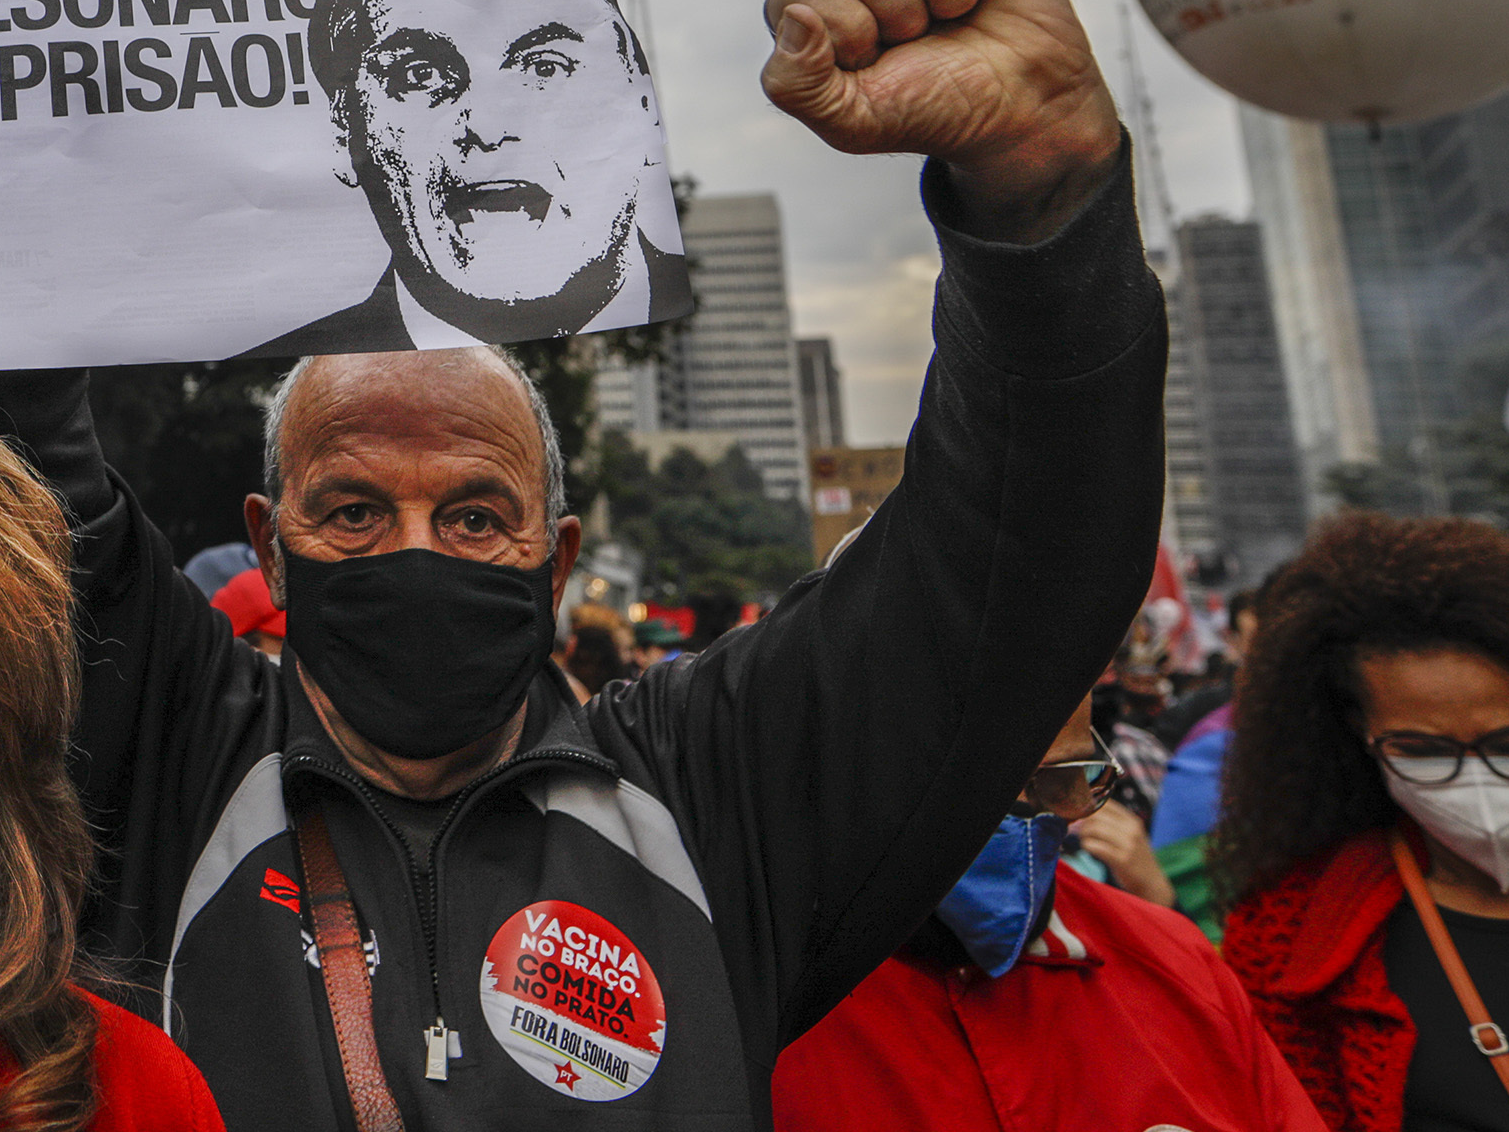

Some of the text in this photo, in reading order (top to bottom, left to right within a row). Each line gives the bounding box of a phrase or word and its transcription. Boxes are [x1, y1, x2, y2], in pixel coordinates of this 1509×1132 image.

[520, 932, 641, 998] NO BRAÇO.
[525, 909, 641, 979] VACINA
[513, 975, 628, 1038] NO PRATO.
[517, 954, 635, 1022] COMIDA
[510, 1005, 630, 1083] FORA BOLSONARO
[560, 1070, 574, 1082] PT
